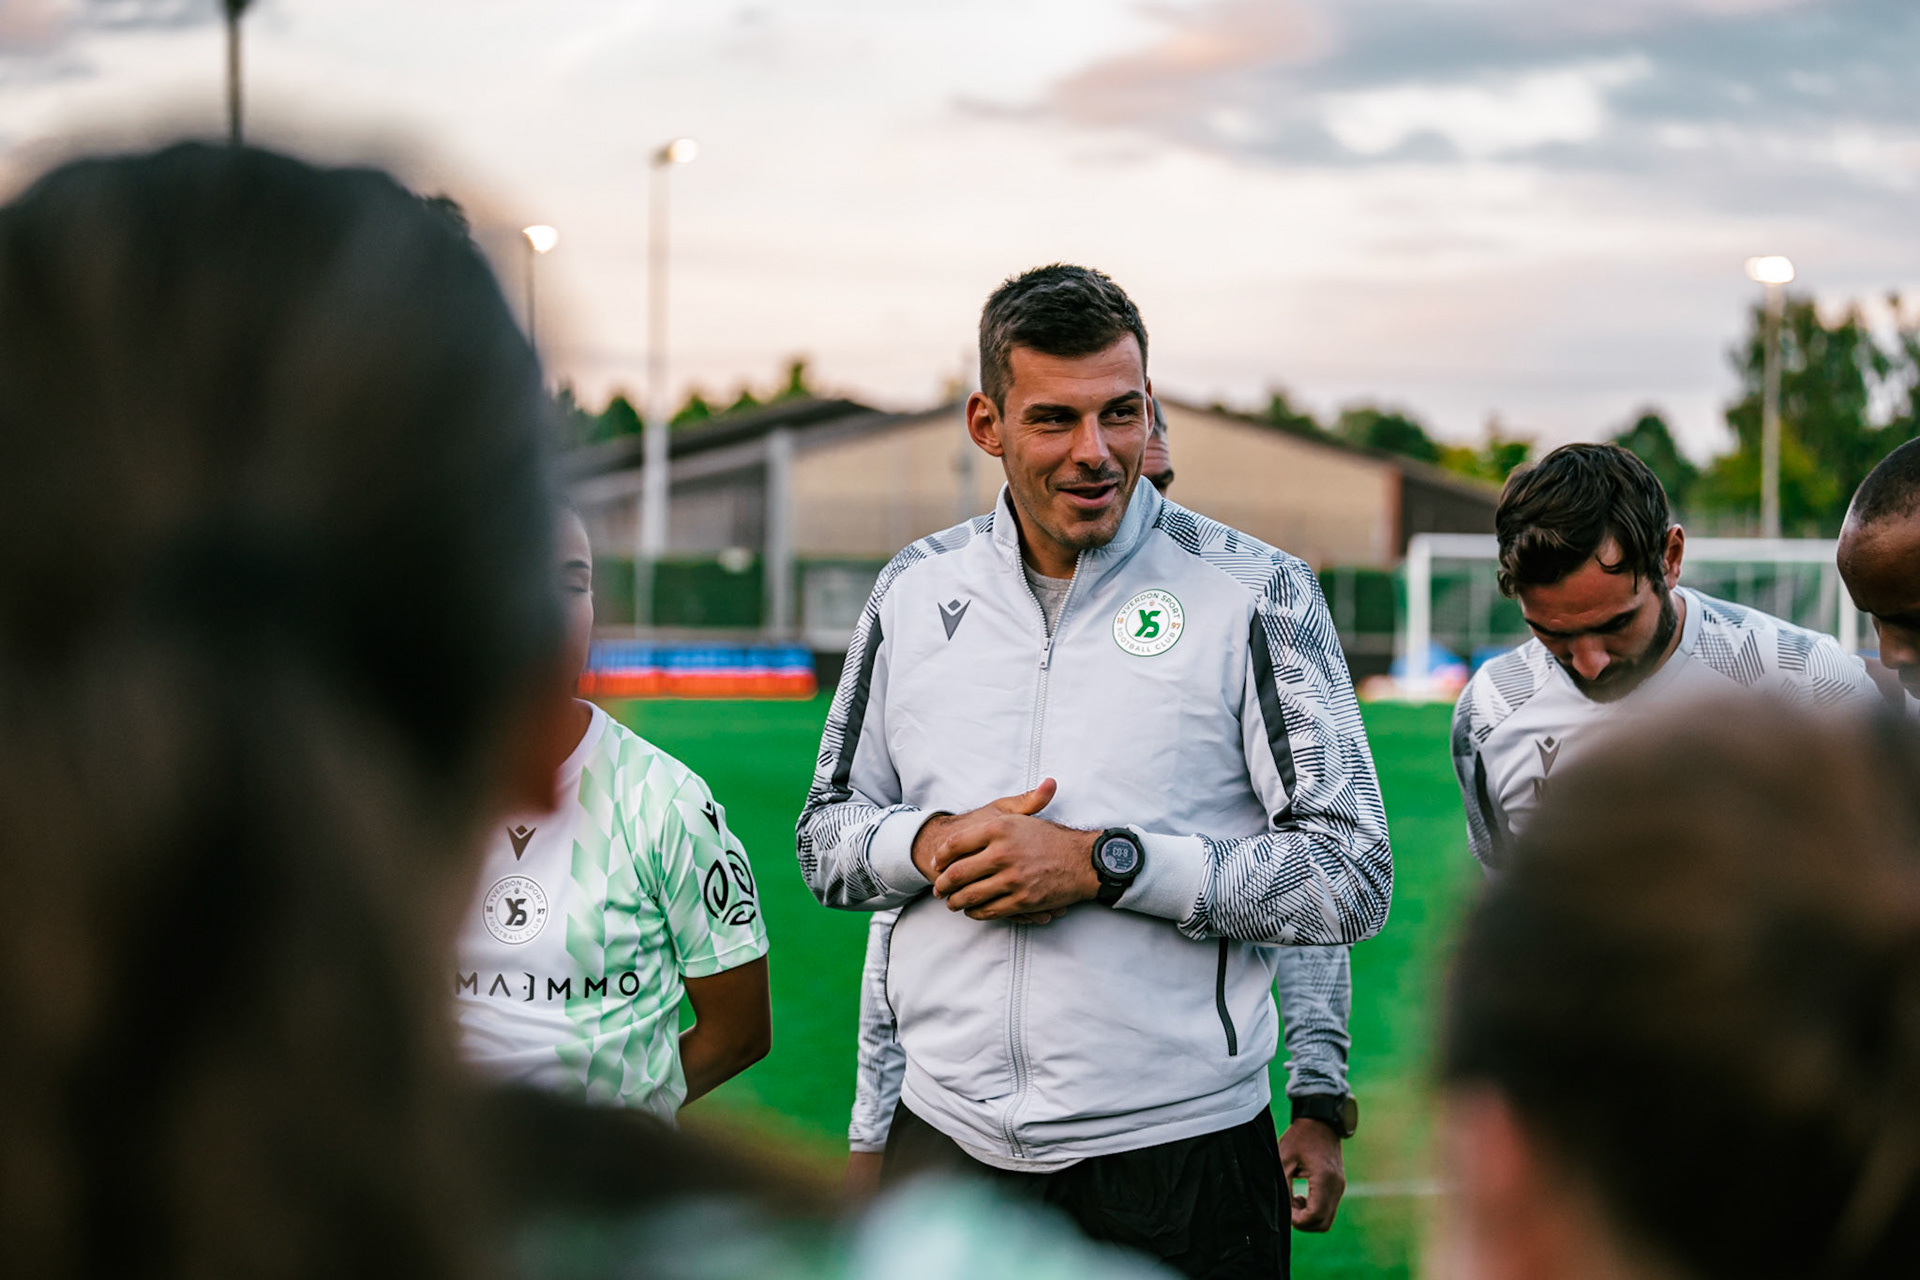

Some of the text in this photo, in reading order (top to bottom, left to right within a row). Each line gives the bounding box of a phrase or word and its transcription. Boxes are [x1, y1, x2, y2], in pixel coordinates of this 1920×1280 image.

[1121, 592, 1181, 618] YVERDON SPORT
[1117, 627, 1176, 653] FOOTBALL CLUB
[488, 880, 544, 904] YVERDON SPORT
[488, 917, 542, 940] FOOTBALL CLUB
